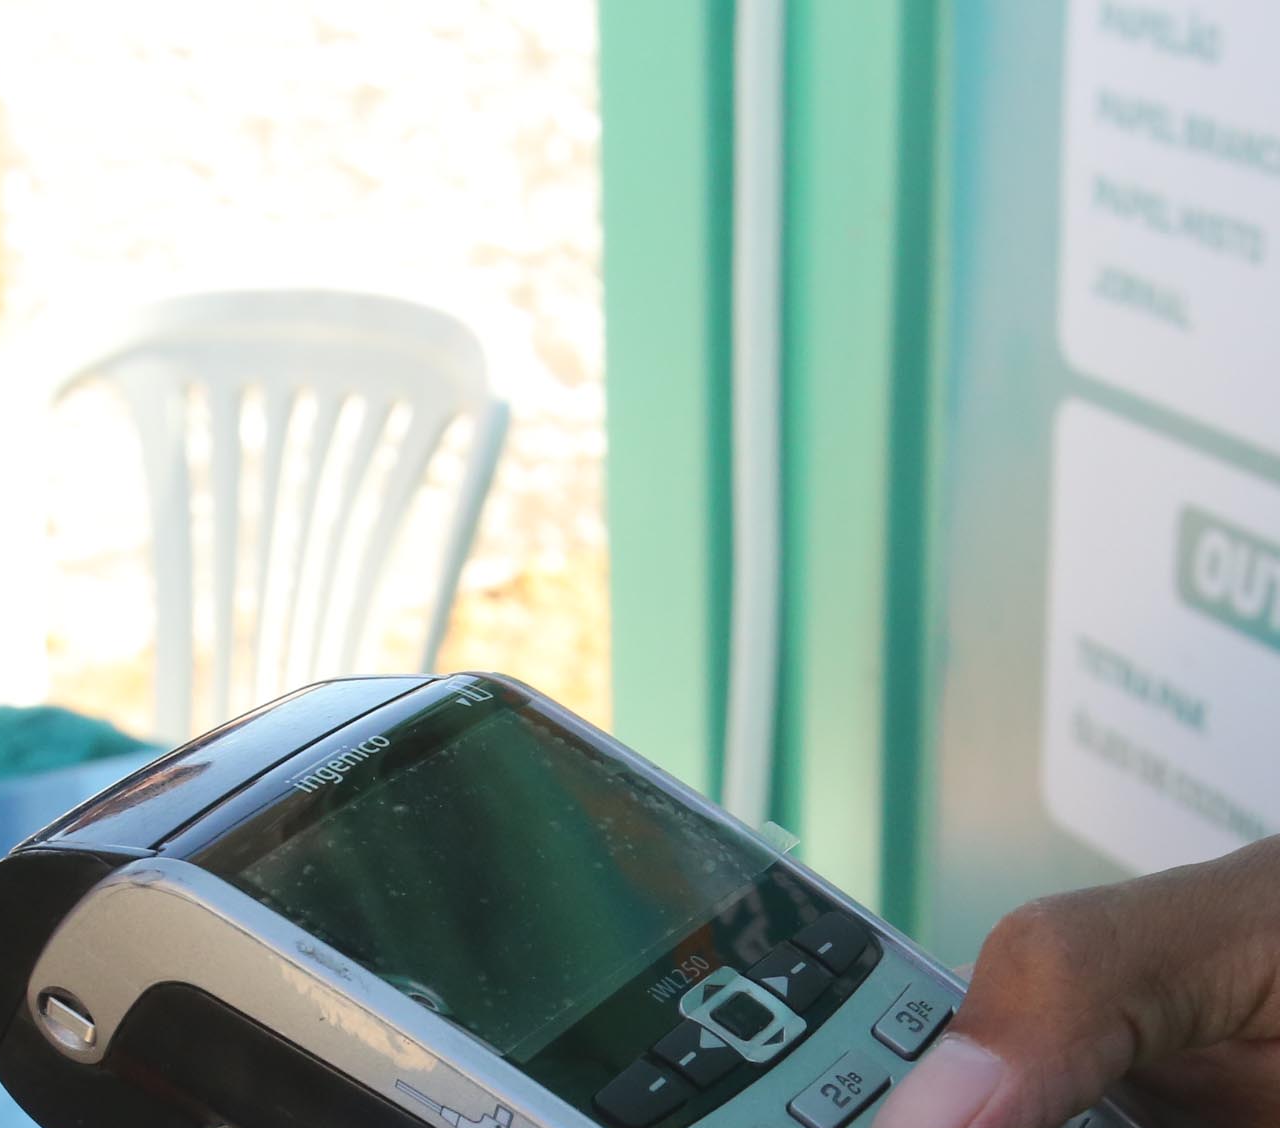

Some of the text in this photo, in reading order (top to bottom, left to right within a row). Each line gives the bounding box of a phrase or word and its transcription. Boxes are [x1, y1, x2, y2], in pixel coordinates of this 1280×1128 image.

[285, 734, 391, 793] ingenico
[646, 955, 710, 1003] iWL250
[895, 1010, 926, 1034] 3
[820, 1082, 851, 1109] 2
